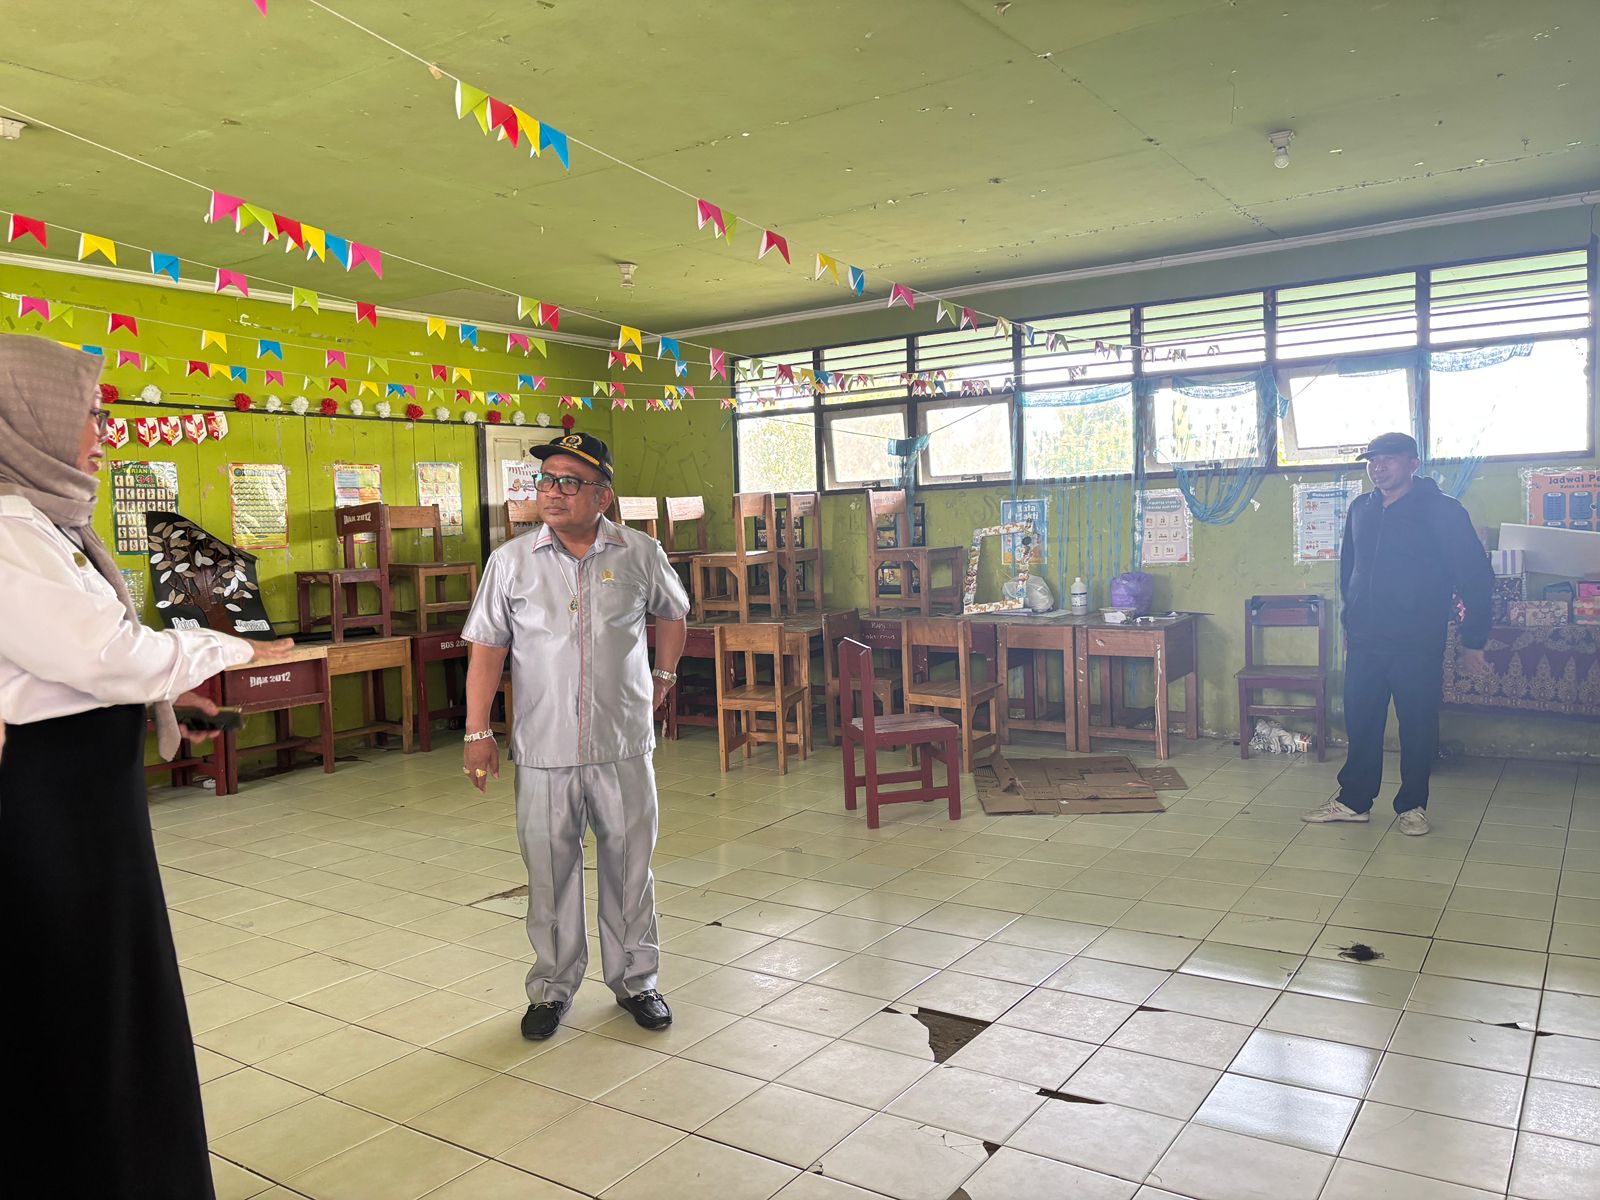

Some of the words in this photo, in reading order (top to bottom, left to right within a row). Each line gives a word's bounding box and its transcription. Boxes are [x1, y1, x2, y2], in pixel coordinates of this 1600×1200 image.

[137, 474, 155, 485] 34
[1548, 475, 1585, 485] Jadwal
[343, 514, 356, 525] DAK
[356, 511, 372, 522] 2012
[440, 642, 455, 650] BOS
[249, 676, 269, 688] DAK
[269, 671, 292, 683] 2012
